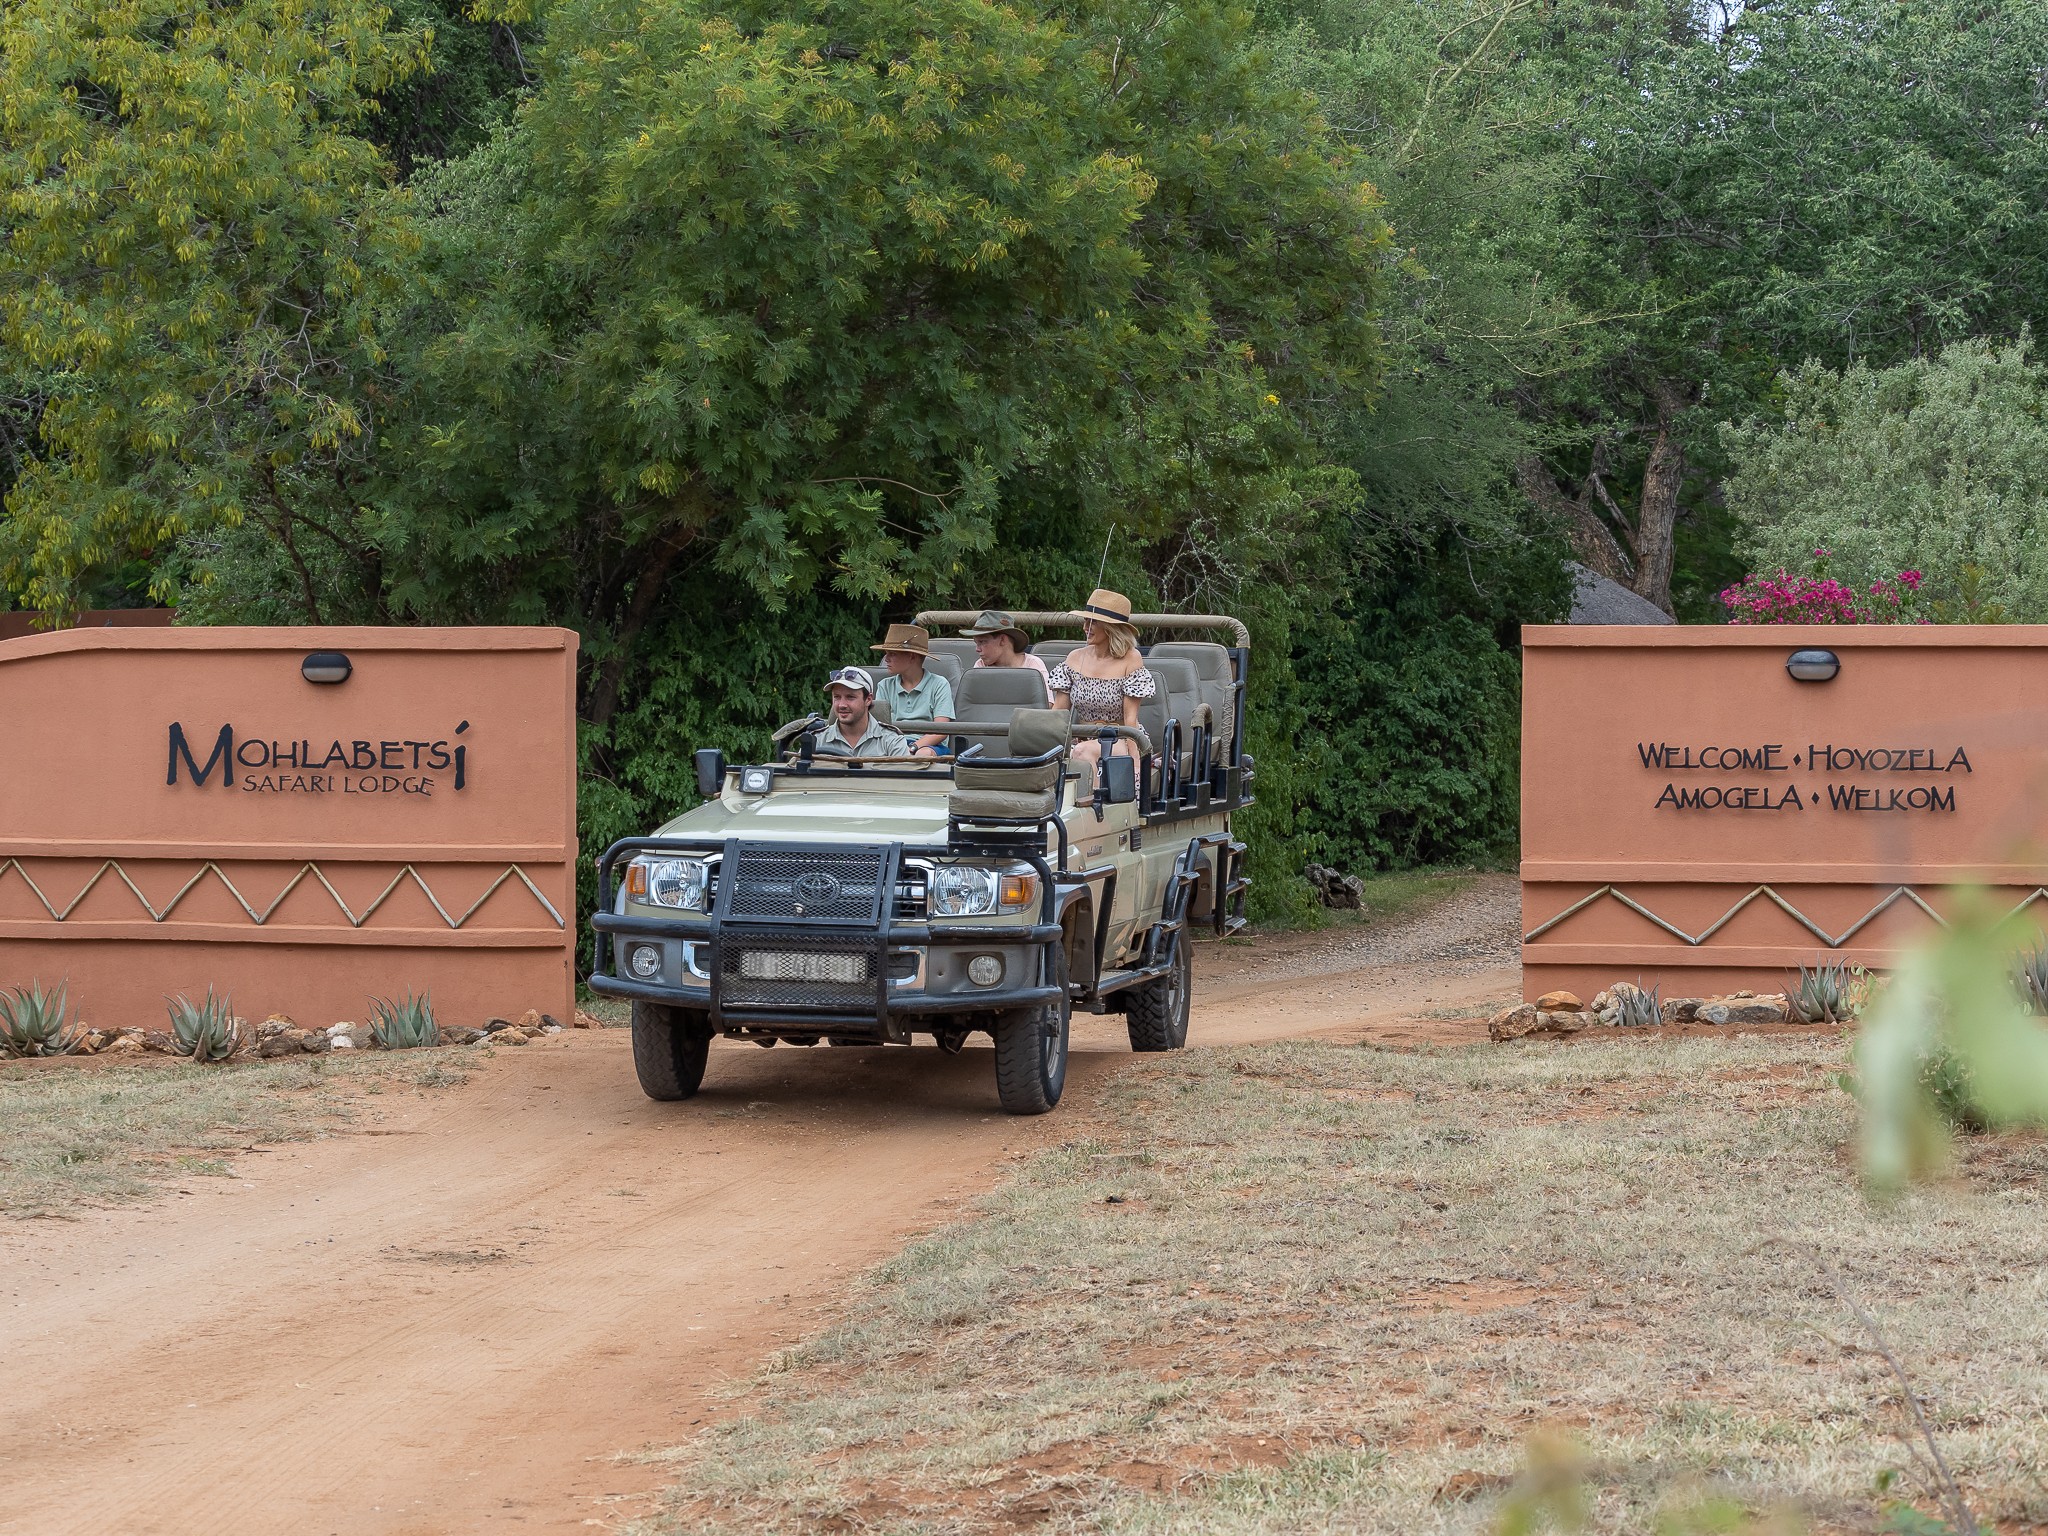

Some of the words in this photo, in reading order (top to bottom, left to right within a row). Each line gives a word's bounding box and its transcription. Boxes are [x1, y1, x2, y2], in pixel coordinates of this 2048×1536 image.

[1637, 741, 1789, 772] WELCOME
[1808, 744, 1974, 773] HOYOZELA
[242, 774, 334, 794] SAFARI
[343, 775, 435, 797] LODGE
[1653, 783, 1804, 811] AMOGELA
[1827, 784, 1957, 812] WELKOM
